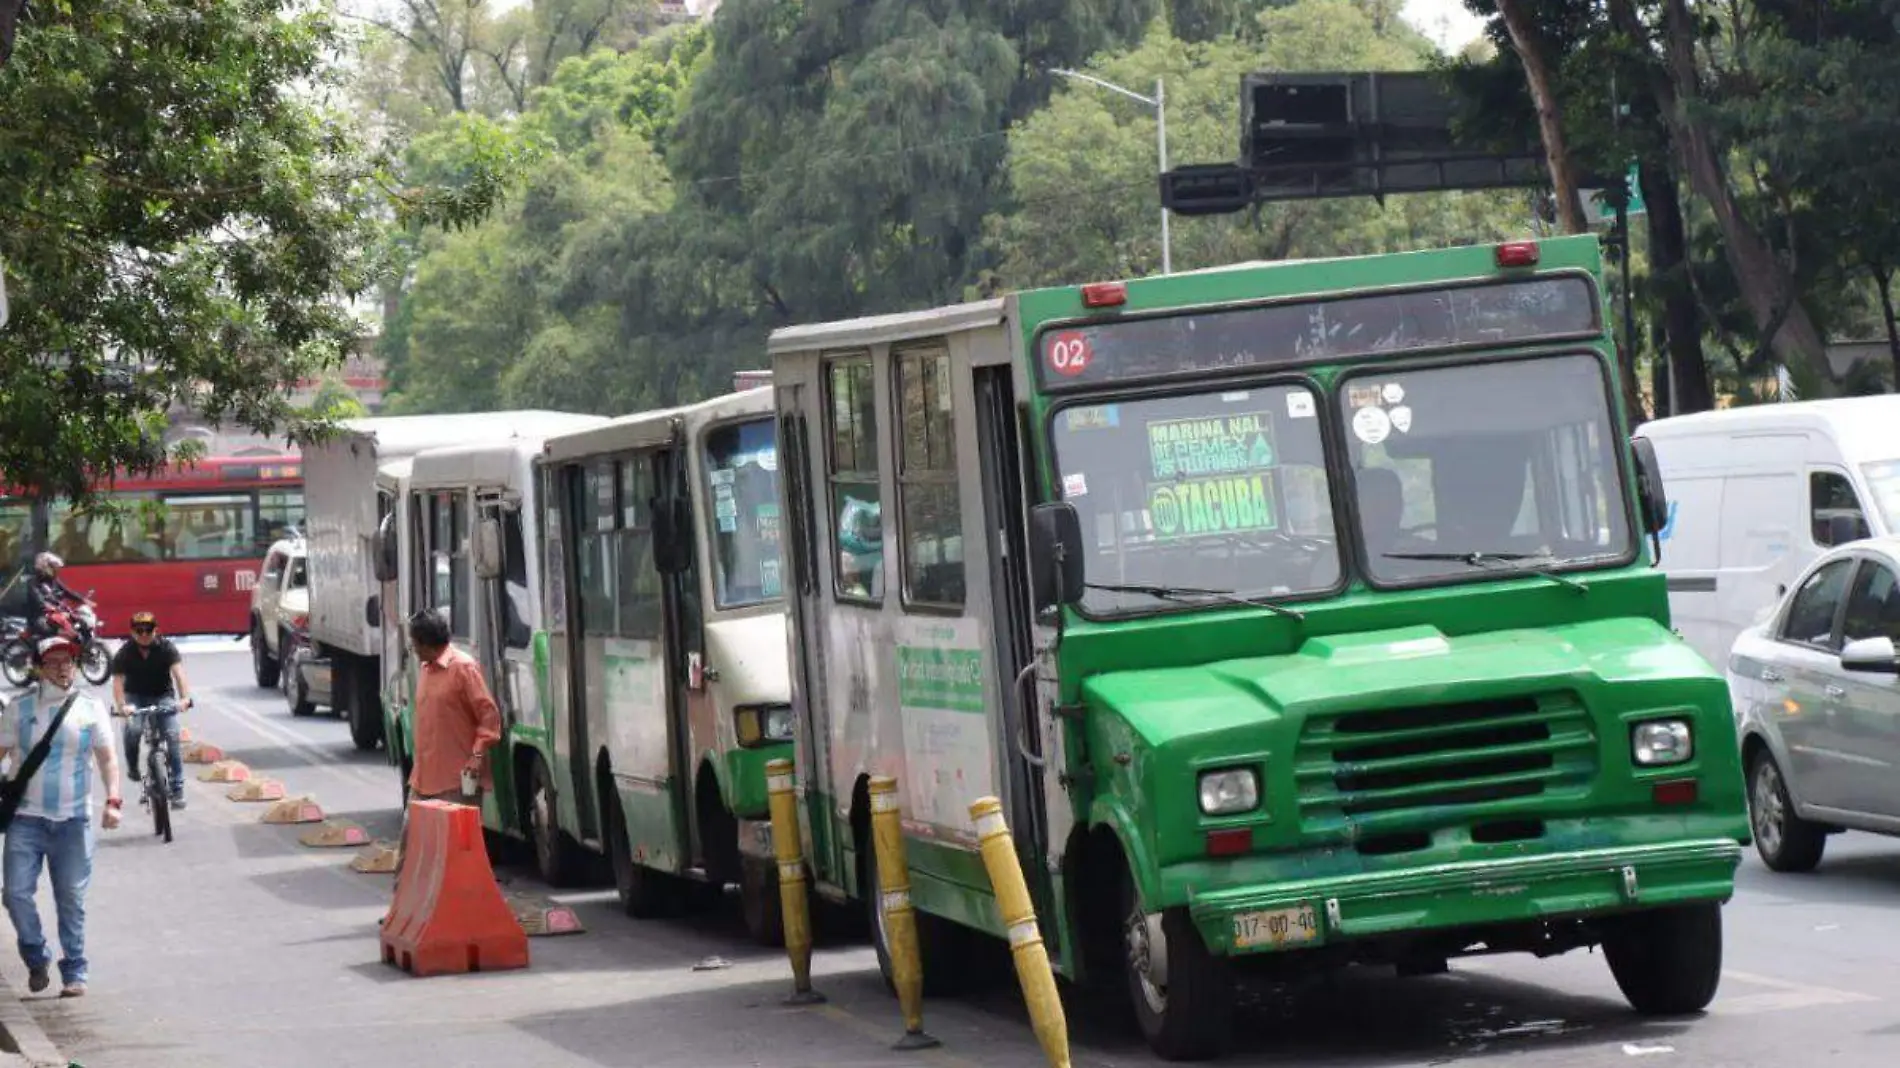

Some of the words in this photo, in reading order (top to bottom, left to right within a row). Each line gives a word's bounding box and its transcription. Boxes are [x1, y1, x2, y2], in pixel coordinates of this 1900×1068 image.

[1054, 339, 1084, 368] 02
[1152, 419, 1226, 443] MARINA
[1174, 433, 1249, 458] PEMEX
